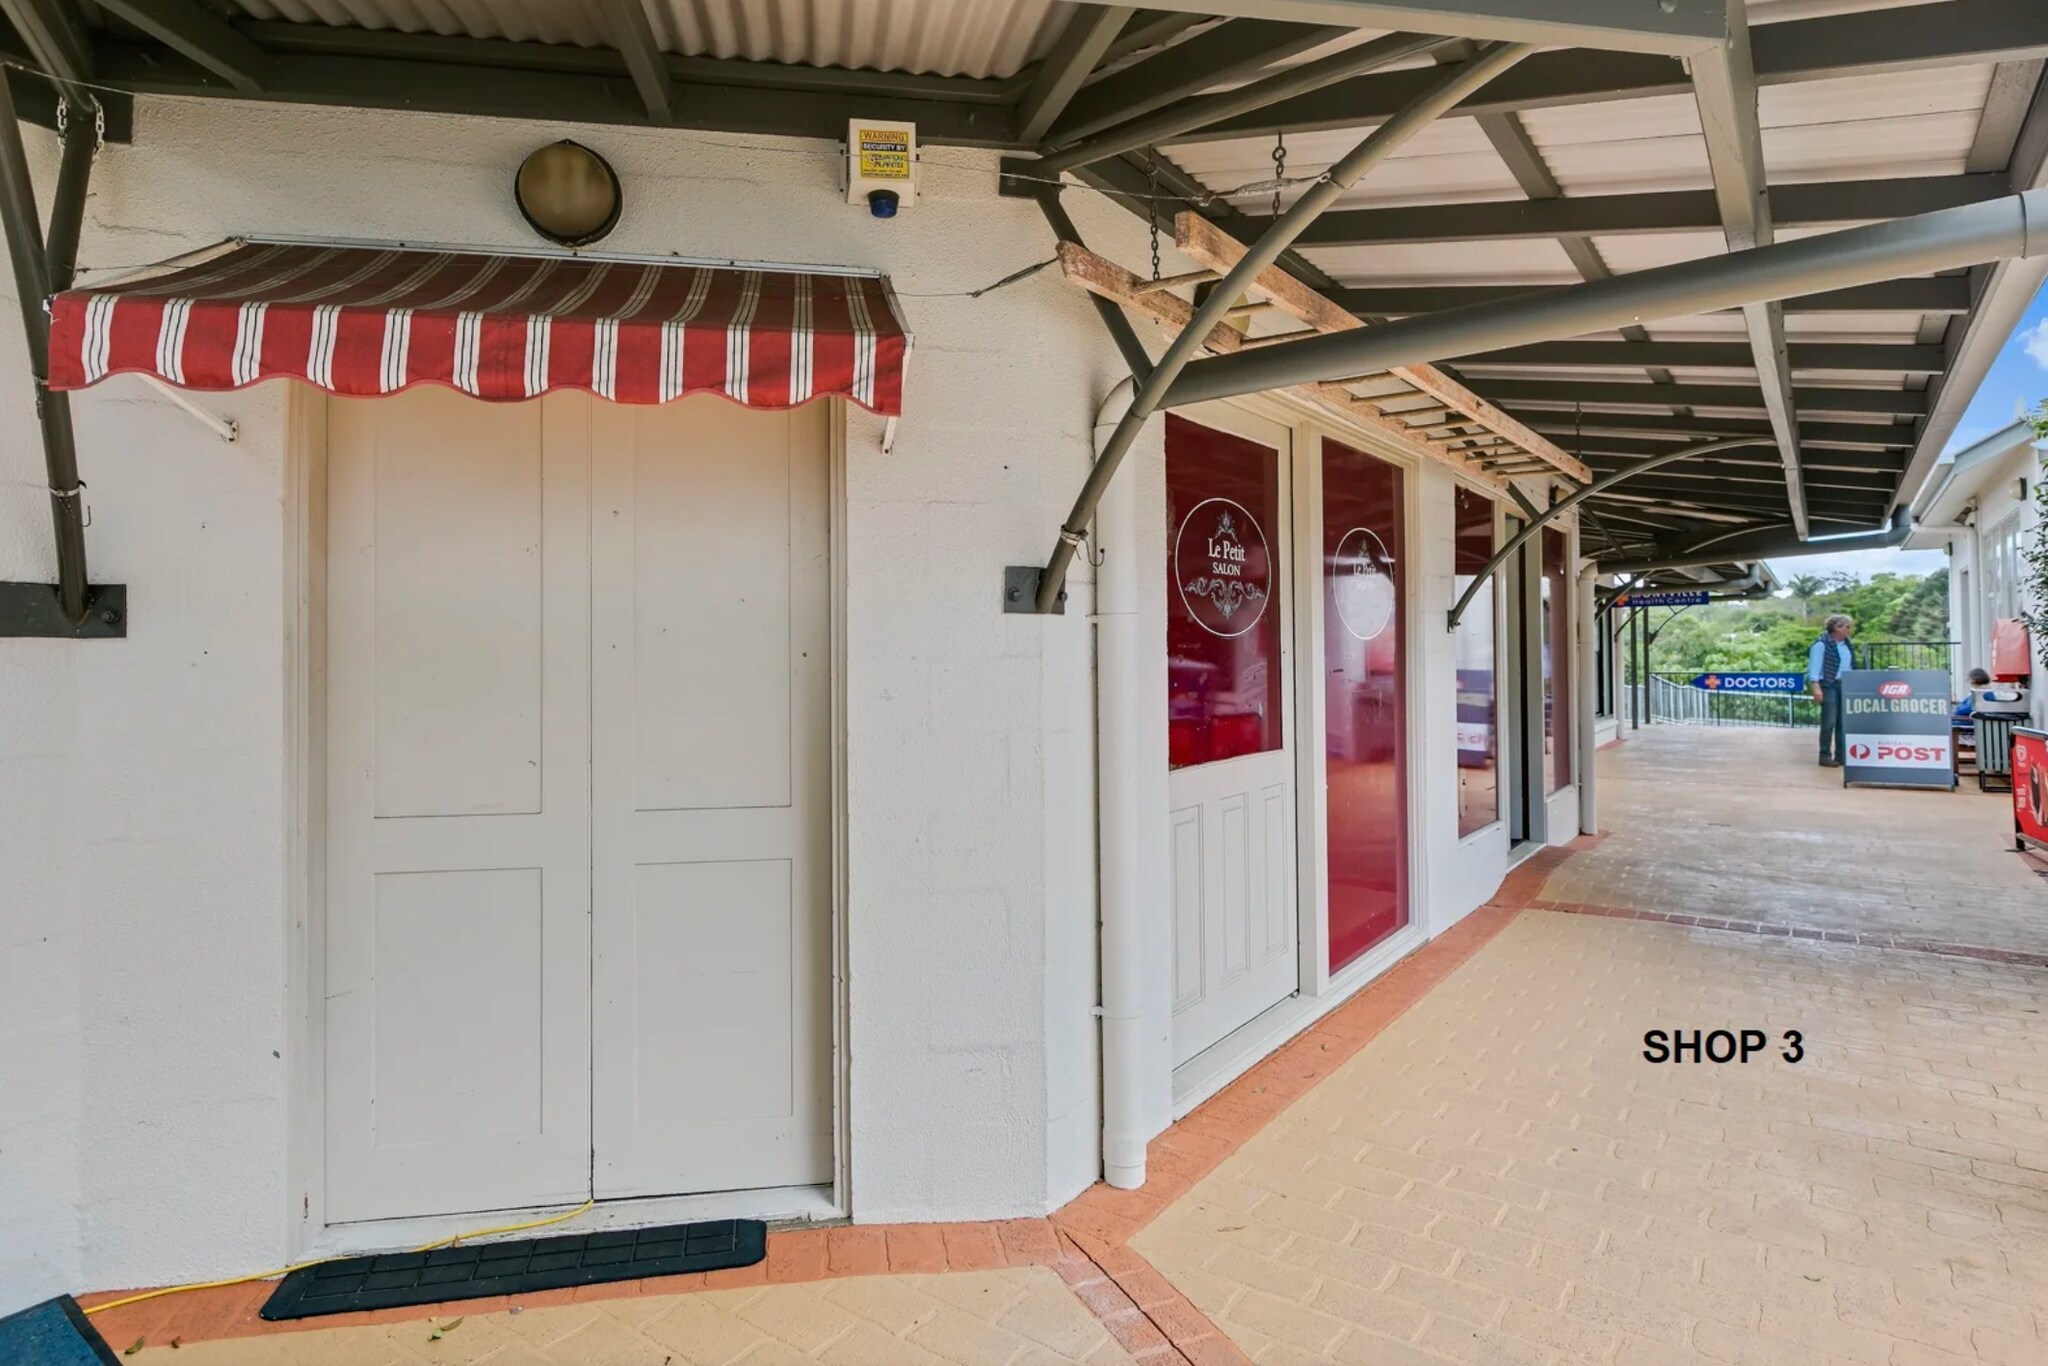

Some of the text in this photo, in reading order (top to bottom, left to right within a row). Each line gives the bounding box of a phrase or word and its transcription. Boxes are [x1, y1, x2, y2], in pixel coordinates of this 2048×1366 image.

[863, 131, 905, 141] WARNING
[863, 142, 895, 150] SECURITY
[1208, 537, 1246, 562] Le Petit
[1212, 561, 1241, 577] SALON
[1631, 597, 1702, 606] Health Centre
[1724, 677, 1796, 690] DOCTORS
[1881, 684, 1909, 695] IGA
[1846, 698, 1948, 716] LOCAL GROCER
[1877, 746, 1947, 762] POST
